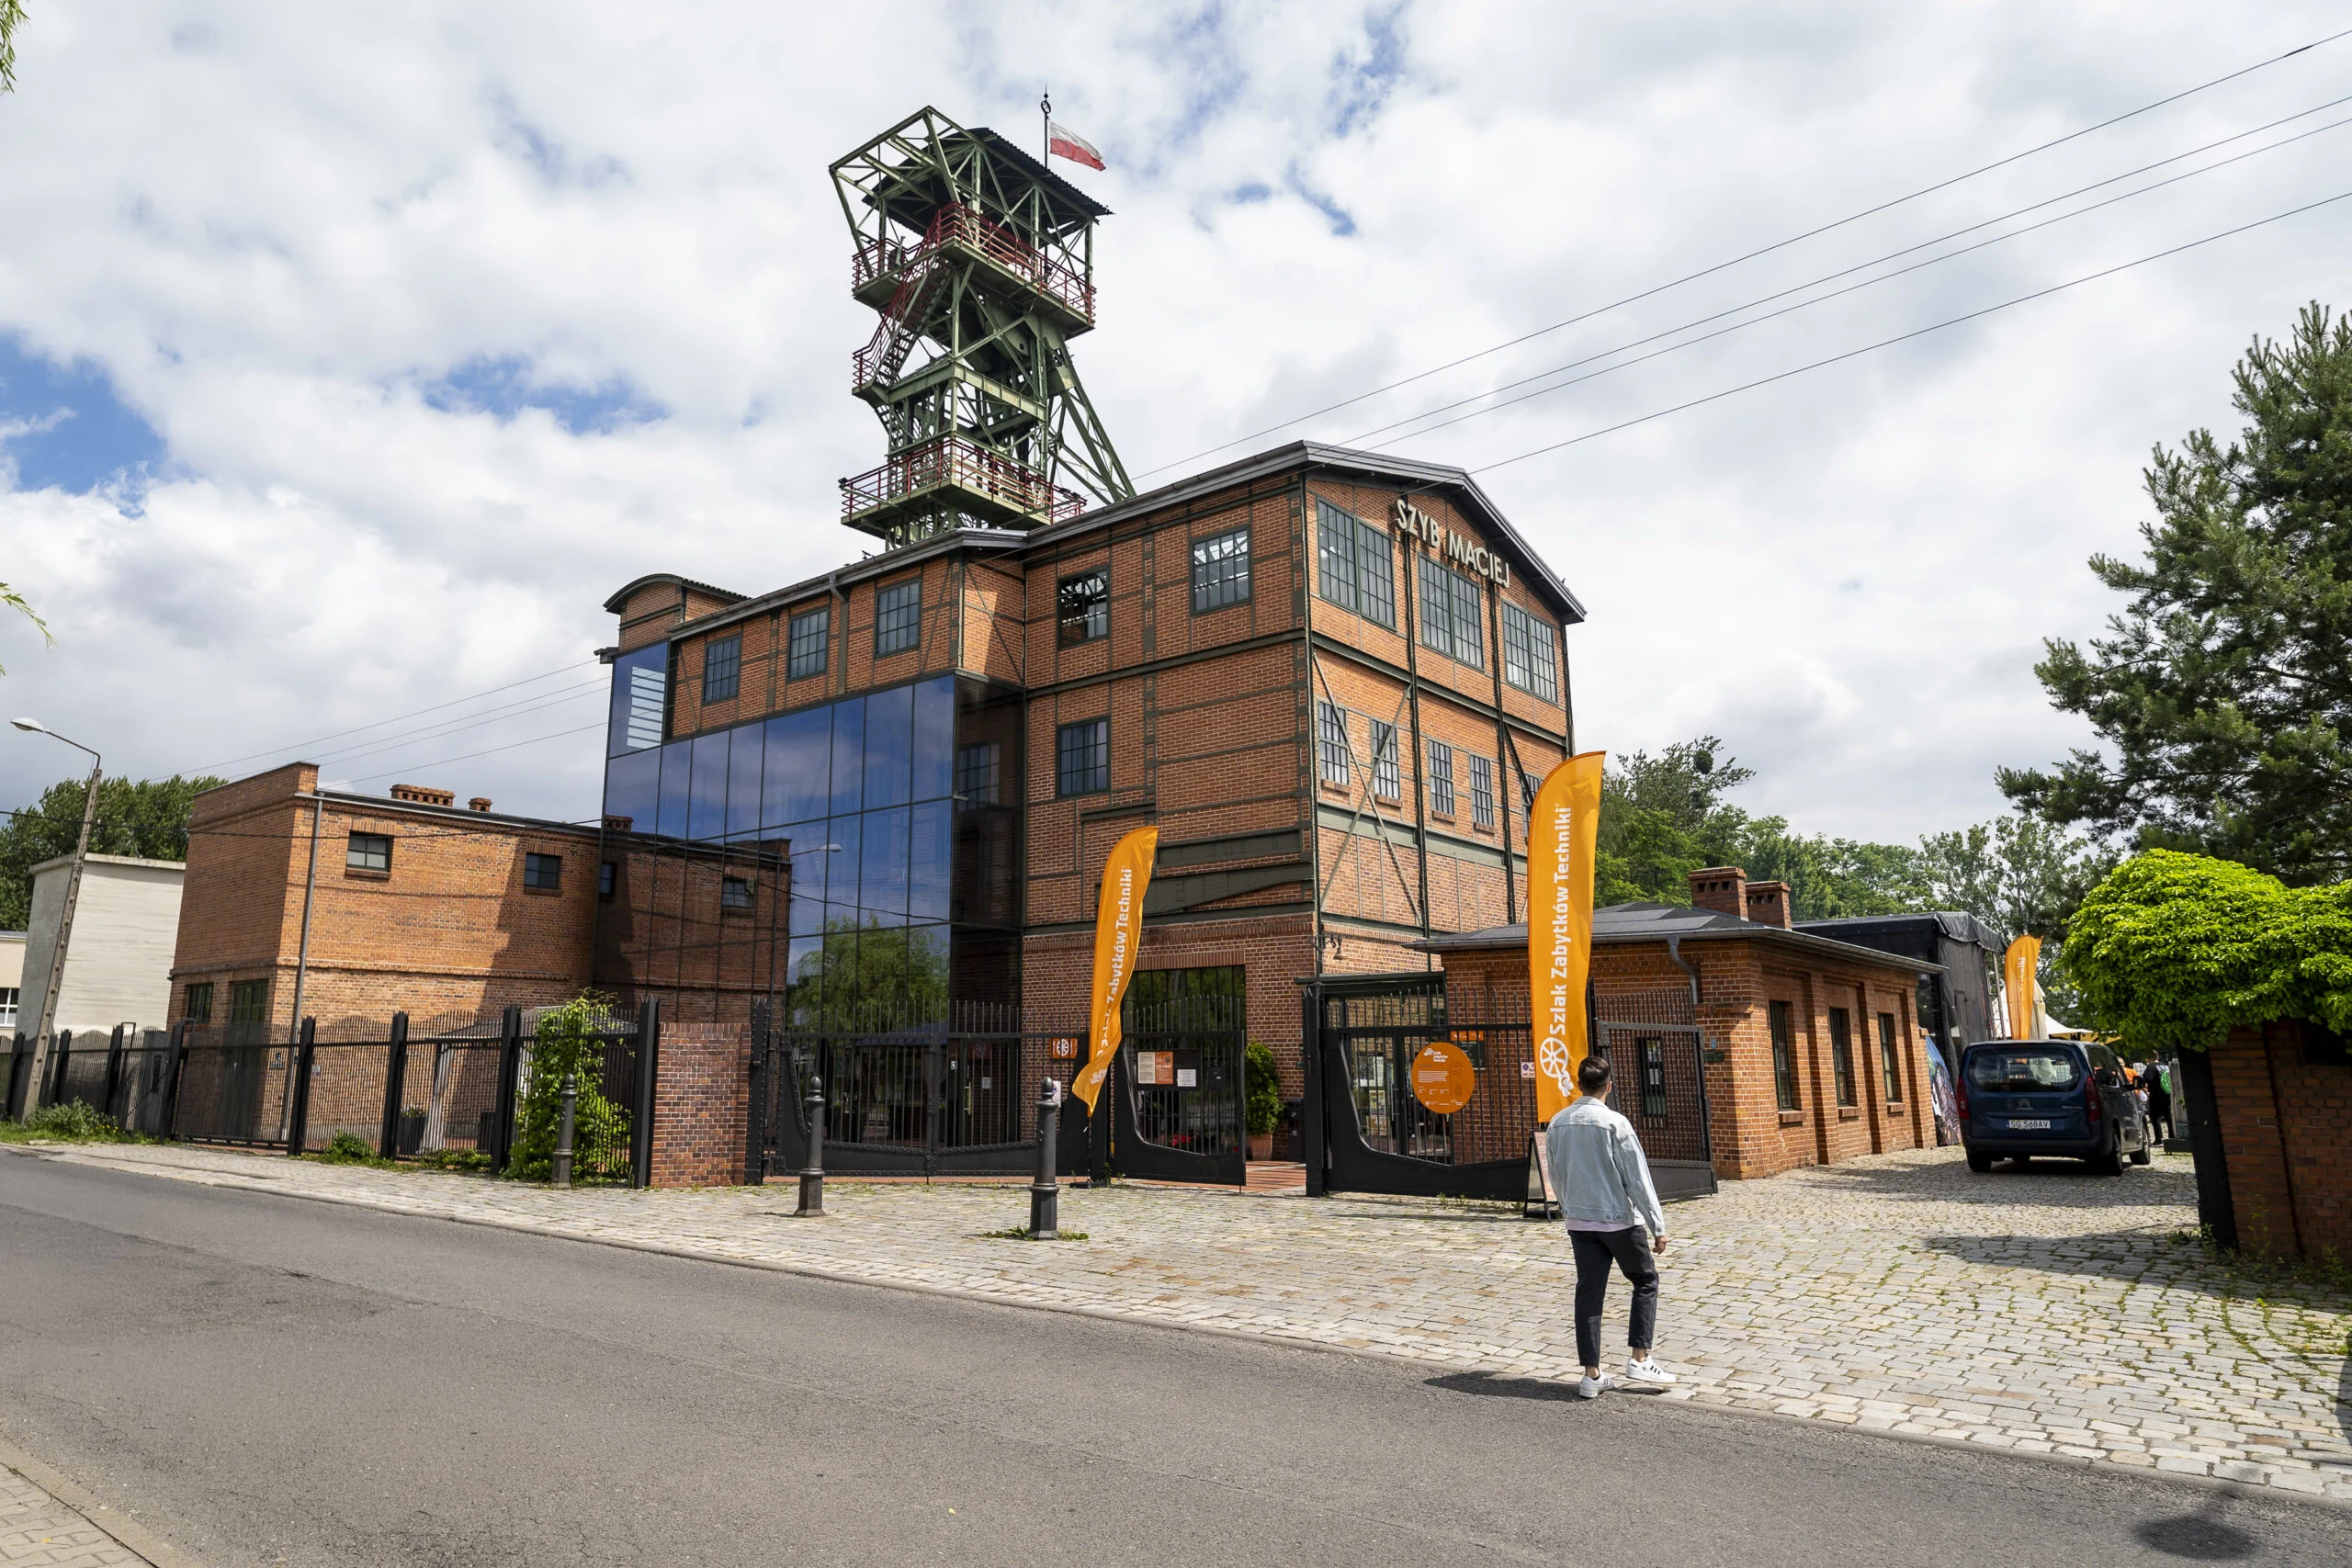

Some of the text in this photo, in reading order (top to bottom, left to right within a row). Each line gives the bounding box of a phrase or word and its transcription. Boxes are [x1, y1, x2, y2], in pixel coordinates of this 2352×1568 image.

[1396, 499, 1510, 589] SZYB MACIEJ
[1115, 868, 1133, 930] Techniki
[1549, 807, 1572, 1035] Szlak Zabytków Techniki
